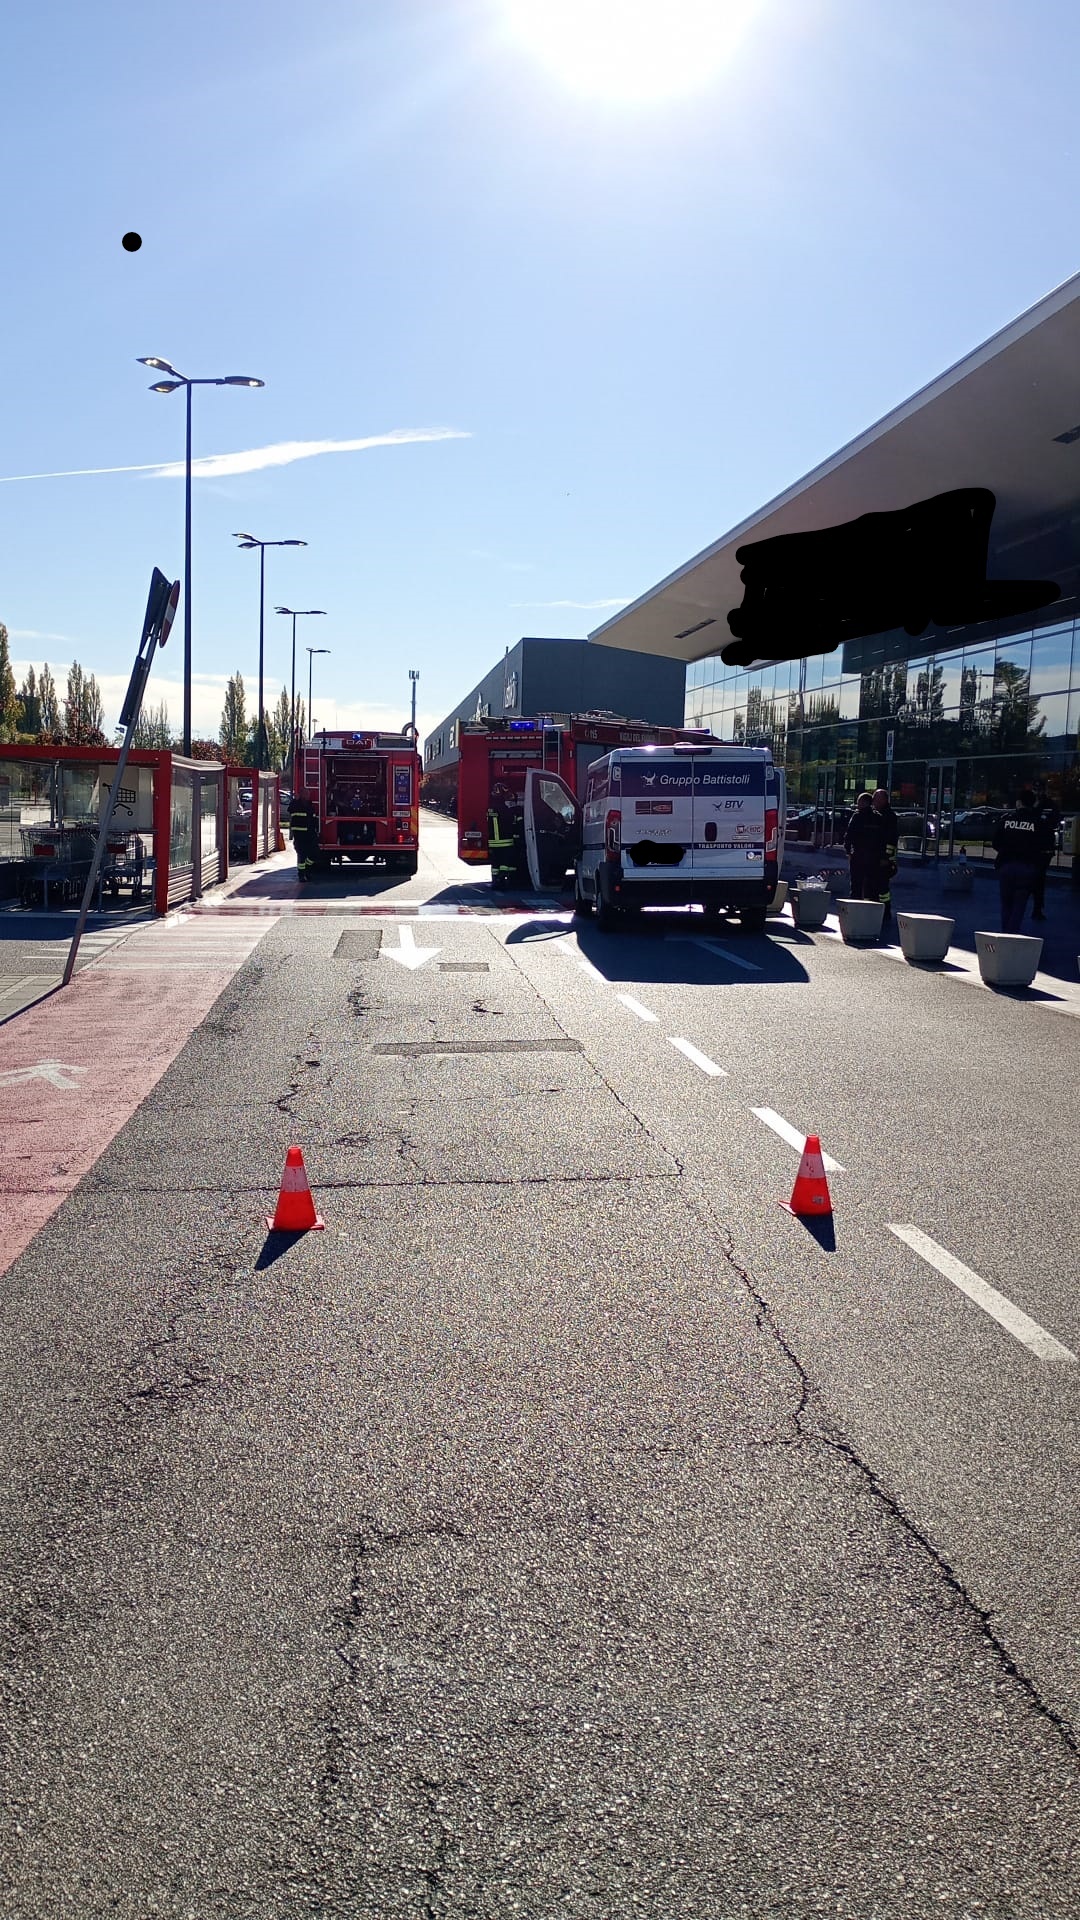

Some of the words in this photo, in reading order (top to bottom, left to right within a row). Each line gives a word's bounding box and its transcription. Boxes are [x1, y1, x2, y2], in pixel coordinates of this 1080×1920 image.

[660, 774, 701, 787] Gruppo
[703, 774, 750, 785] Battistolli
[724, 800, 744, 809] BTV
[1004, 820, 1035, 832] POLIZIA
